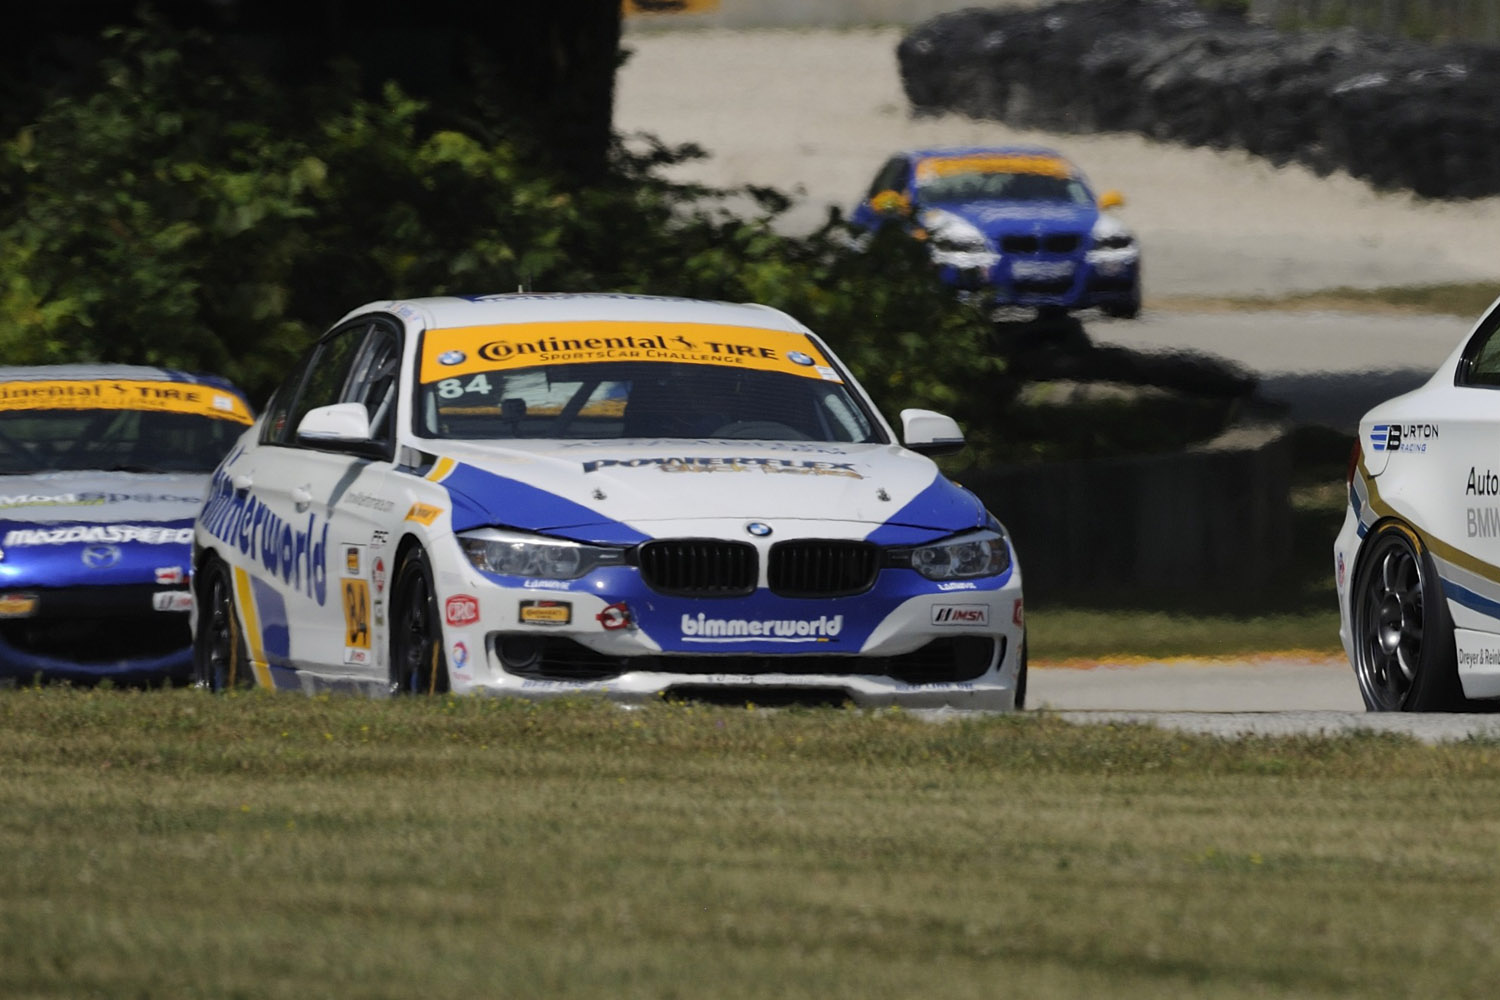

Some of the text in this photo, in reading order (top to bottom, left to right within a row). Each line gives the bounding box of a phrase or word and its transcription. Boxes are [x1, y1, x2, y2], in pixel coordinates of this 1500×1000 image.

[477, 335, 780, 362] Continental TIRE
[135, 386, 201, 403] TIRE
[436, 374, 493, 399] 84
[1386, 424, 1439, 451] BURTON
[3, 525, 195, 547] MAZDASPEED
[680, 613, 844, 637] bimmerworld
[951, 610, 986, 622] IMSA
[1459, 648, 1479, 669] Dreyer
